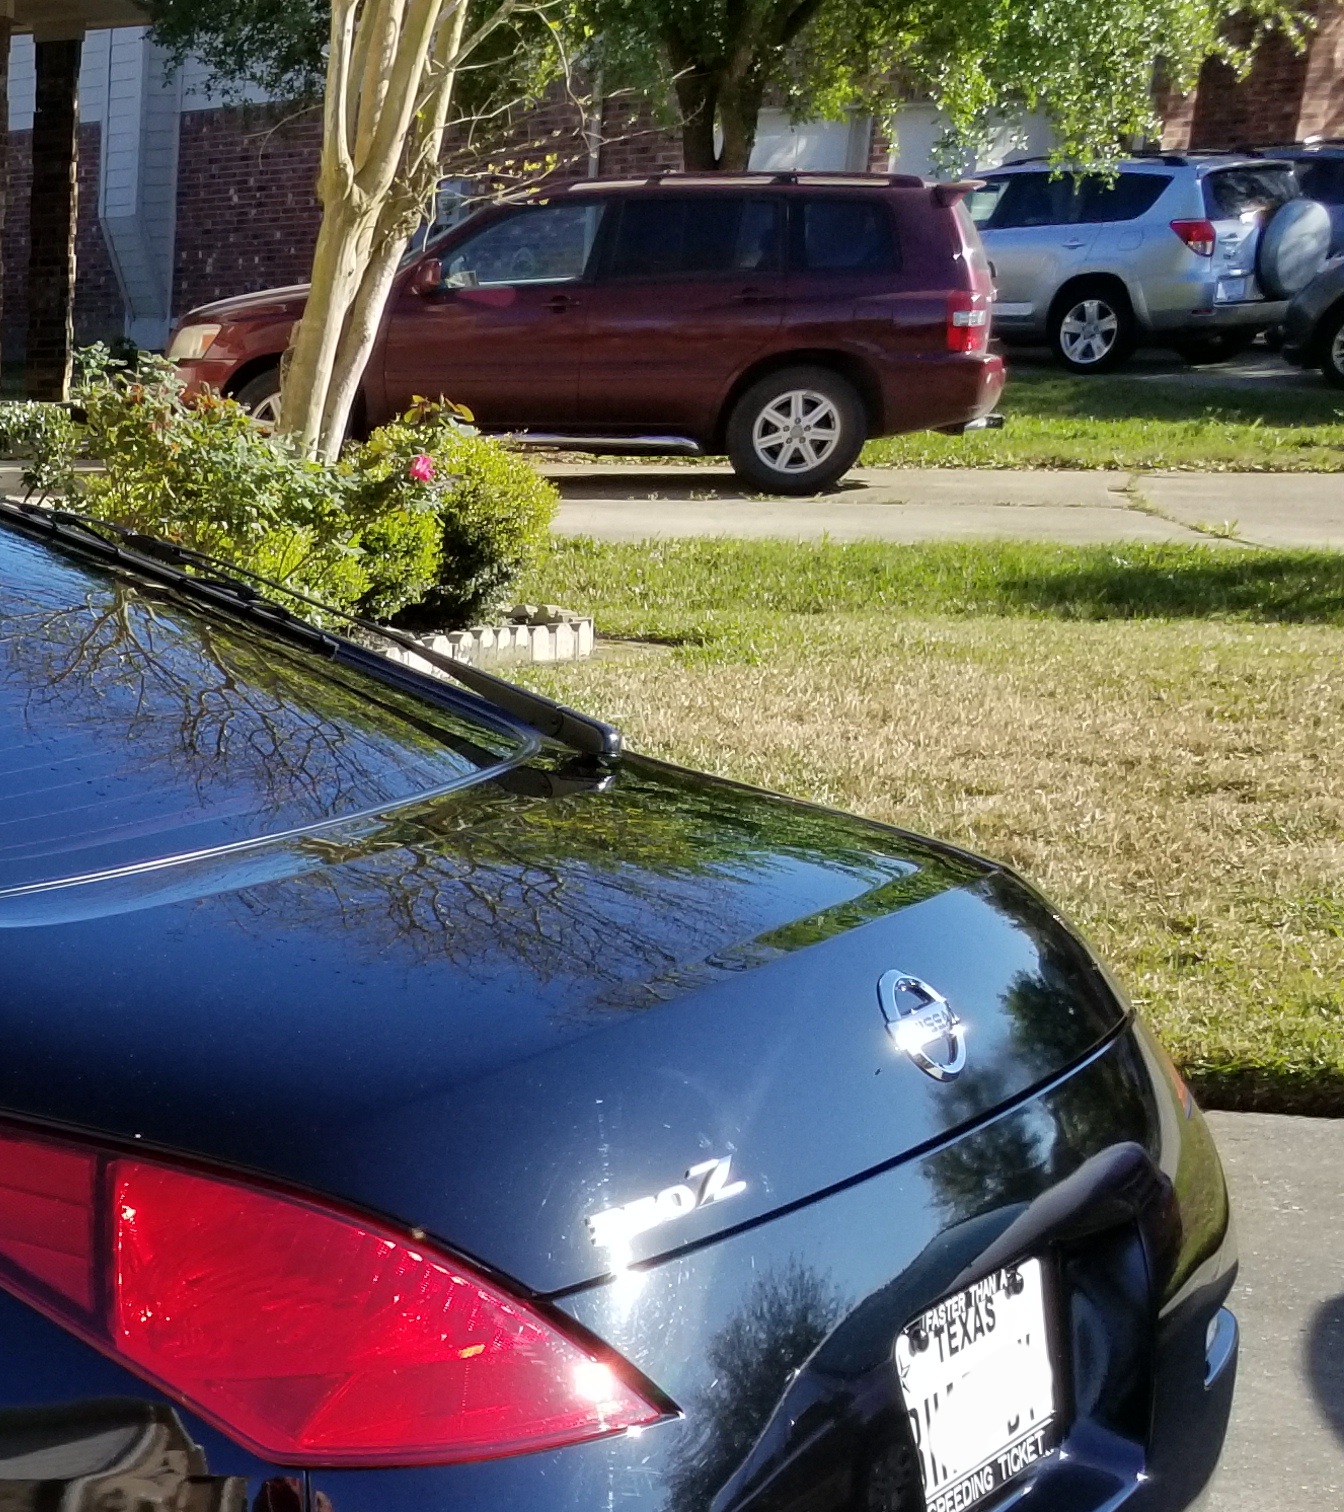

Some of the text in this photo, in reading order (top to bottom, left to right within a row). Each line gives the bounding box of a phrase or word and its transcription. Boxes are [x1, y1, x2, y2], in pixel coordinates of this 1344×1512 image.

[925, 1292, 966, 1333] FASTER
[968, 1273, 997, 1307] THAN
[933, 1294, 996, 1363] TEXAS
[997, 1429, 1046, 1480] TICKET
